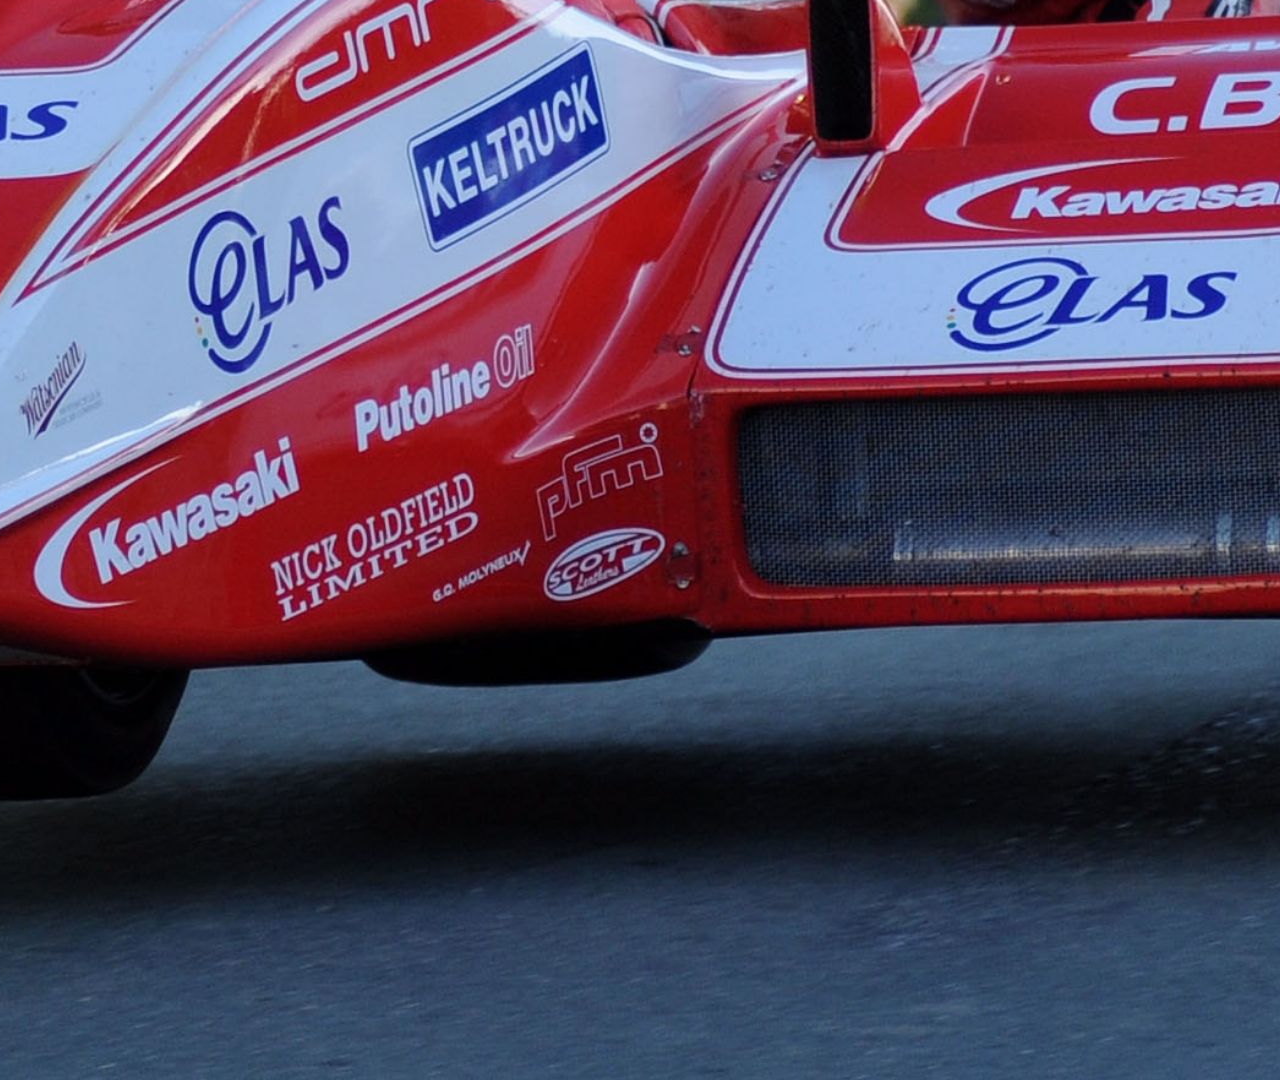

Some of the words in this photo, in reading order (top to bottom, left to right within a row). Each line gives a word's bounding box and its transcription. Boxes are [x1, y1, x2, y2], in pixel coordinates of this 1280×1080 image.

[422, 72, 600, 219] KELTRUCK
[354, 352, 491, 453] Putoline
[493, 322, 535, 390] Oil
[88, 435, 301, 585] Kawasaki
[271, 535, 343, 598] NICK
[347, 472, 475, 564] OLDFIELD
[277, 511, 479, 622] LIMITED
[458, 543, 526, 590] MOLYNEUX
[548, 535, 652, 589] SCOTT
